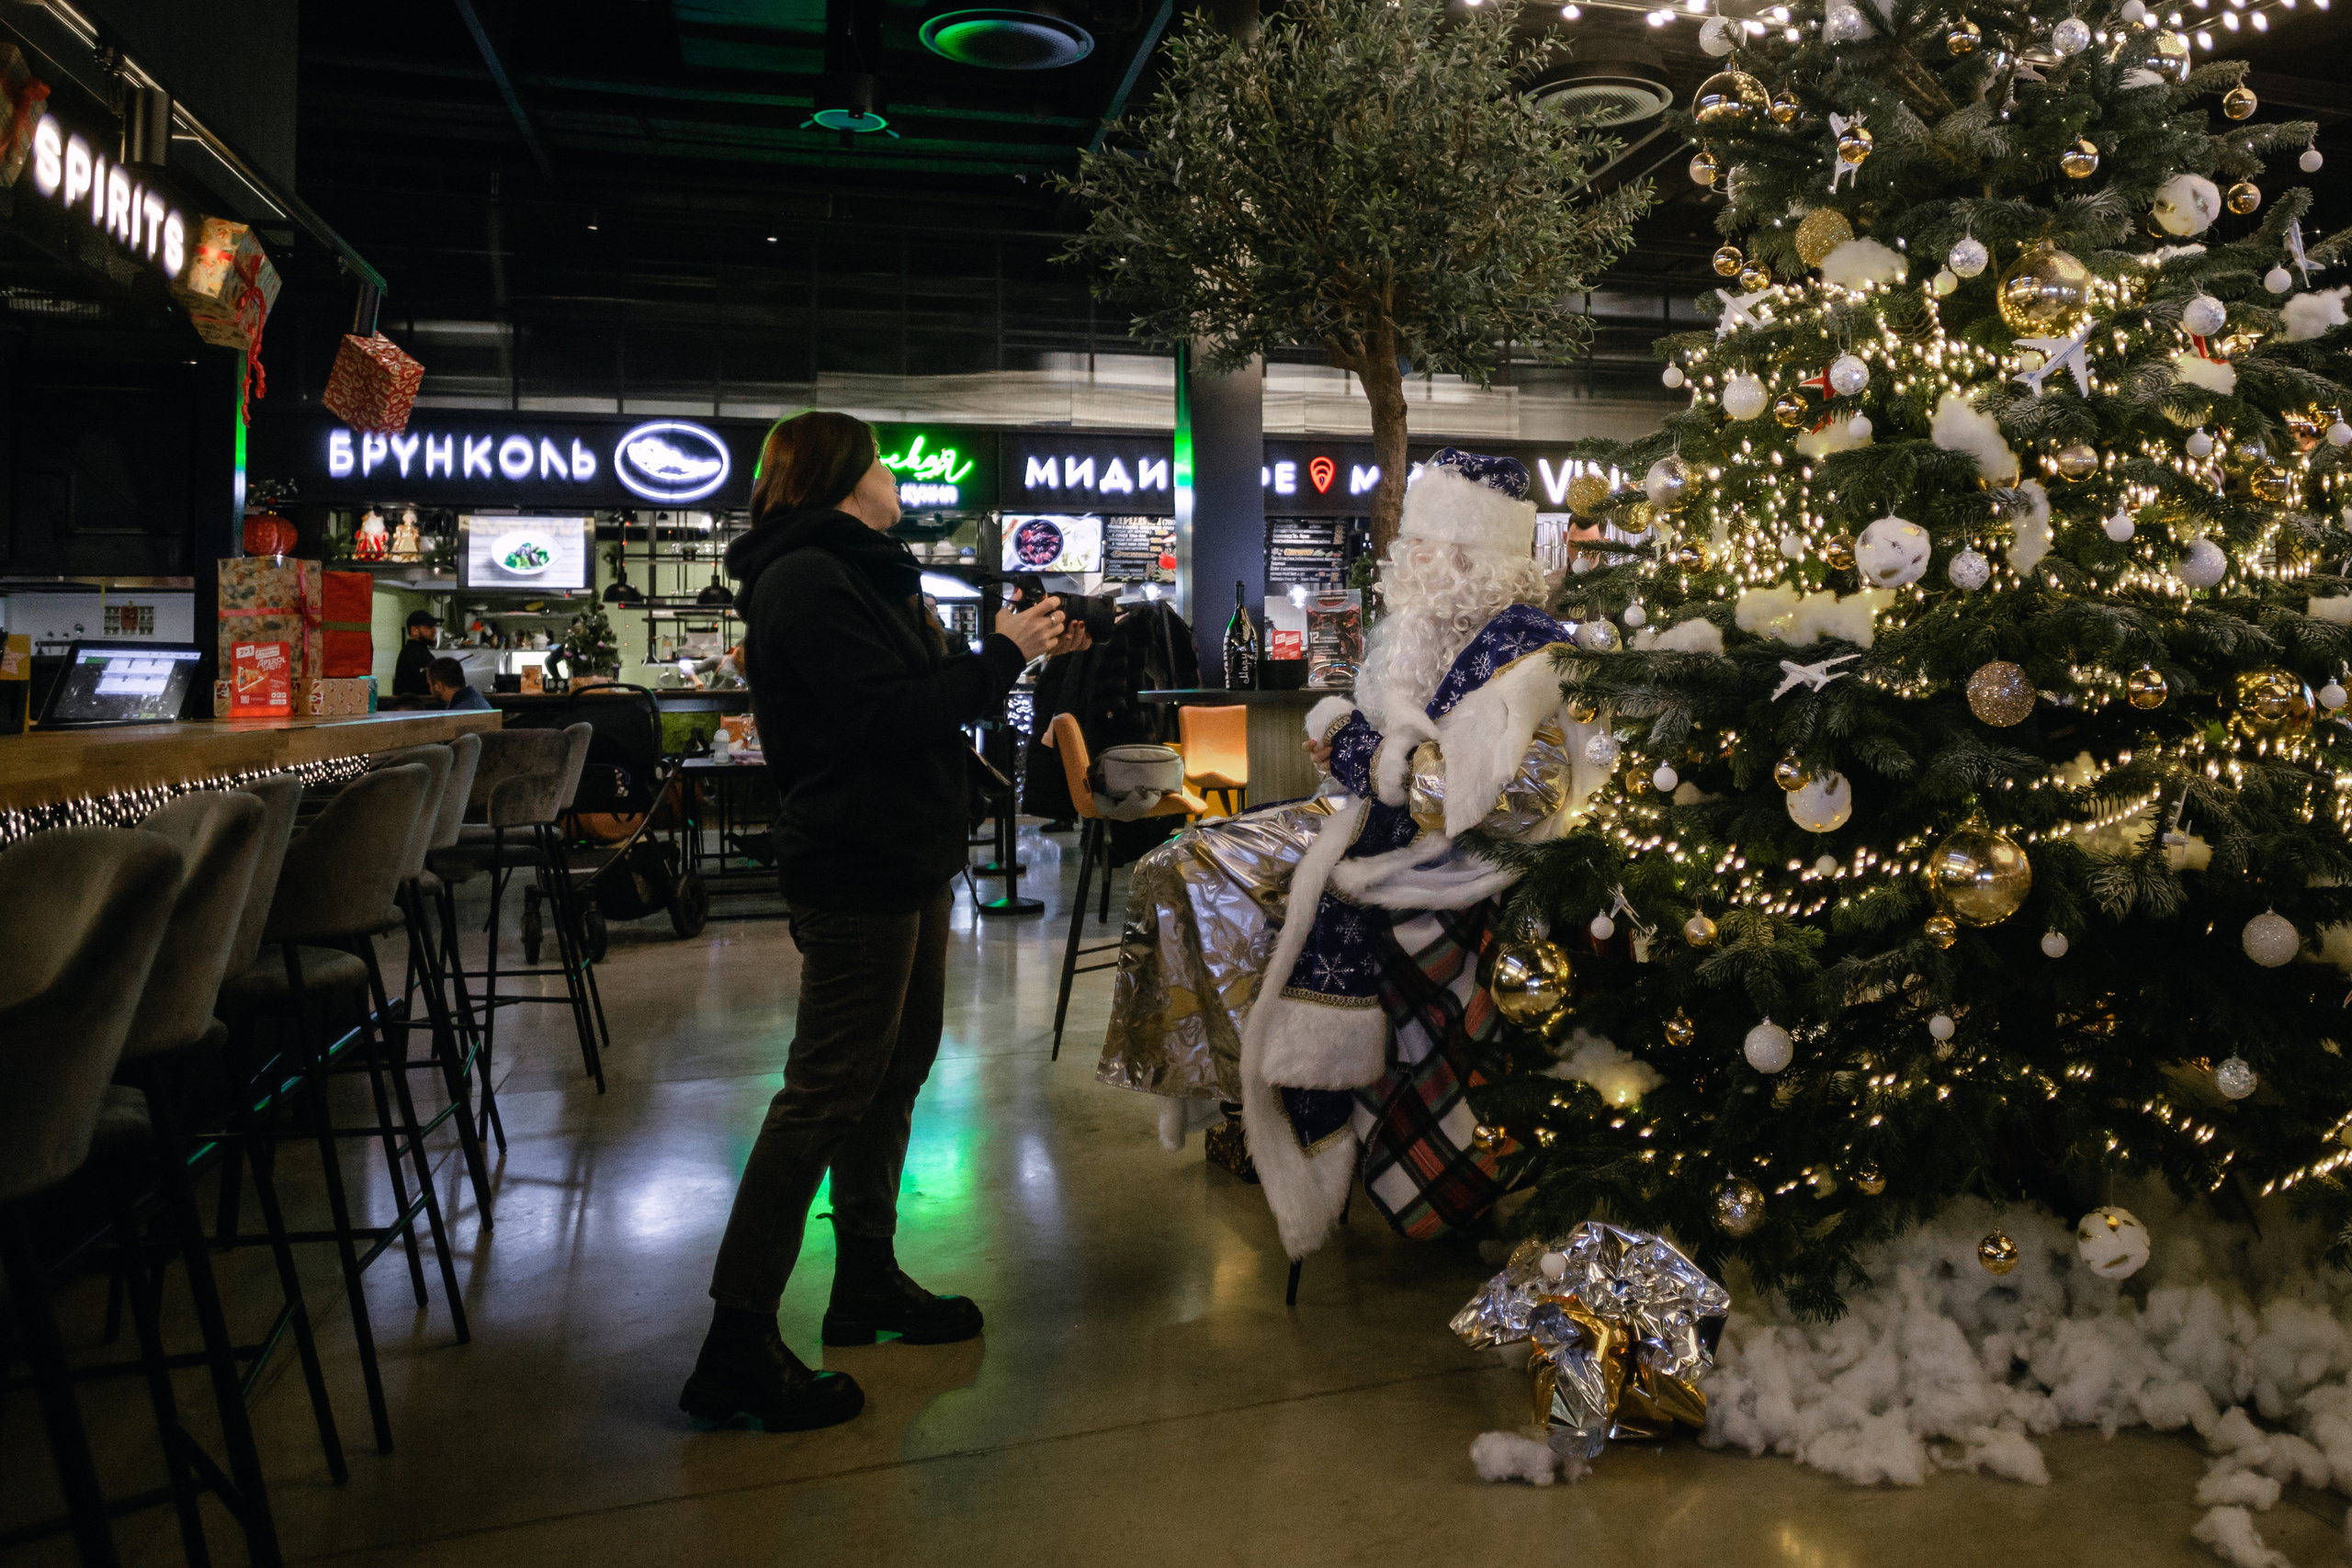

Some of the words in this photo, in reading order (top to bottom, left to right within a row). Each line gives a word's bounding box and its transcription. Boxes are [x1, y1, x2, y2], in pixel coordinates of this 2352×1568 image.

[35, 114, 184, 277] SPIRITS
[331, 428, 597, 479] БРУНКОЛЬ
[1024, 456, 1175, 493] МИДИ
[1309, 632, 1319, 644] 12
[257, 656, 286, 669] APEROL
